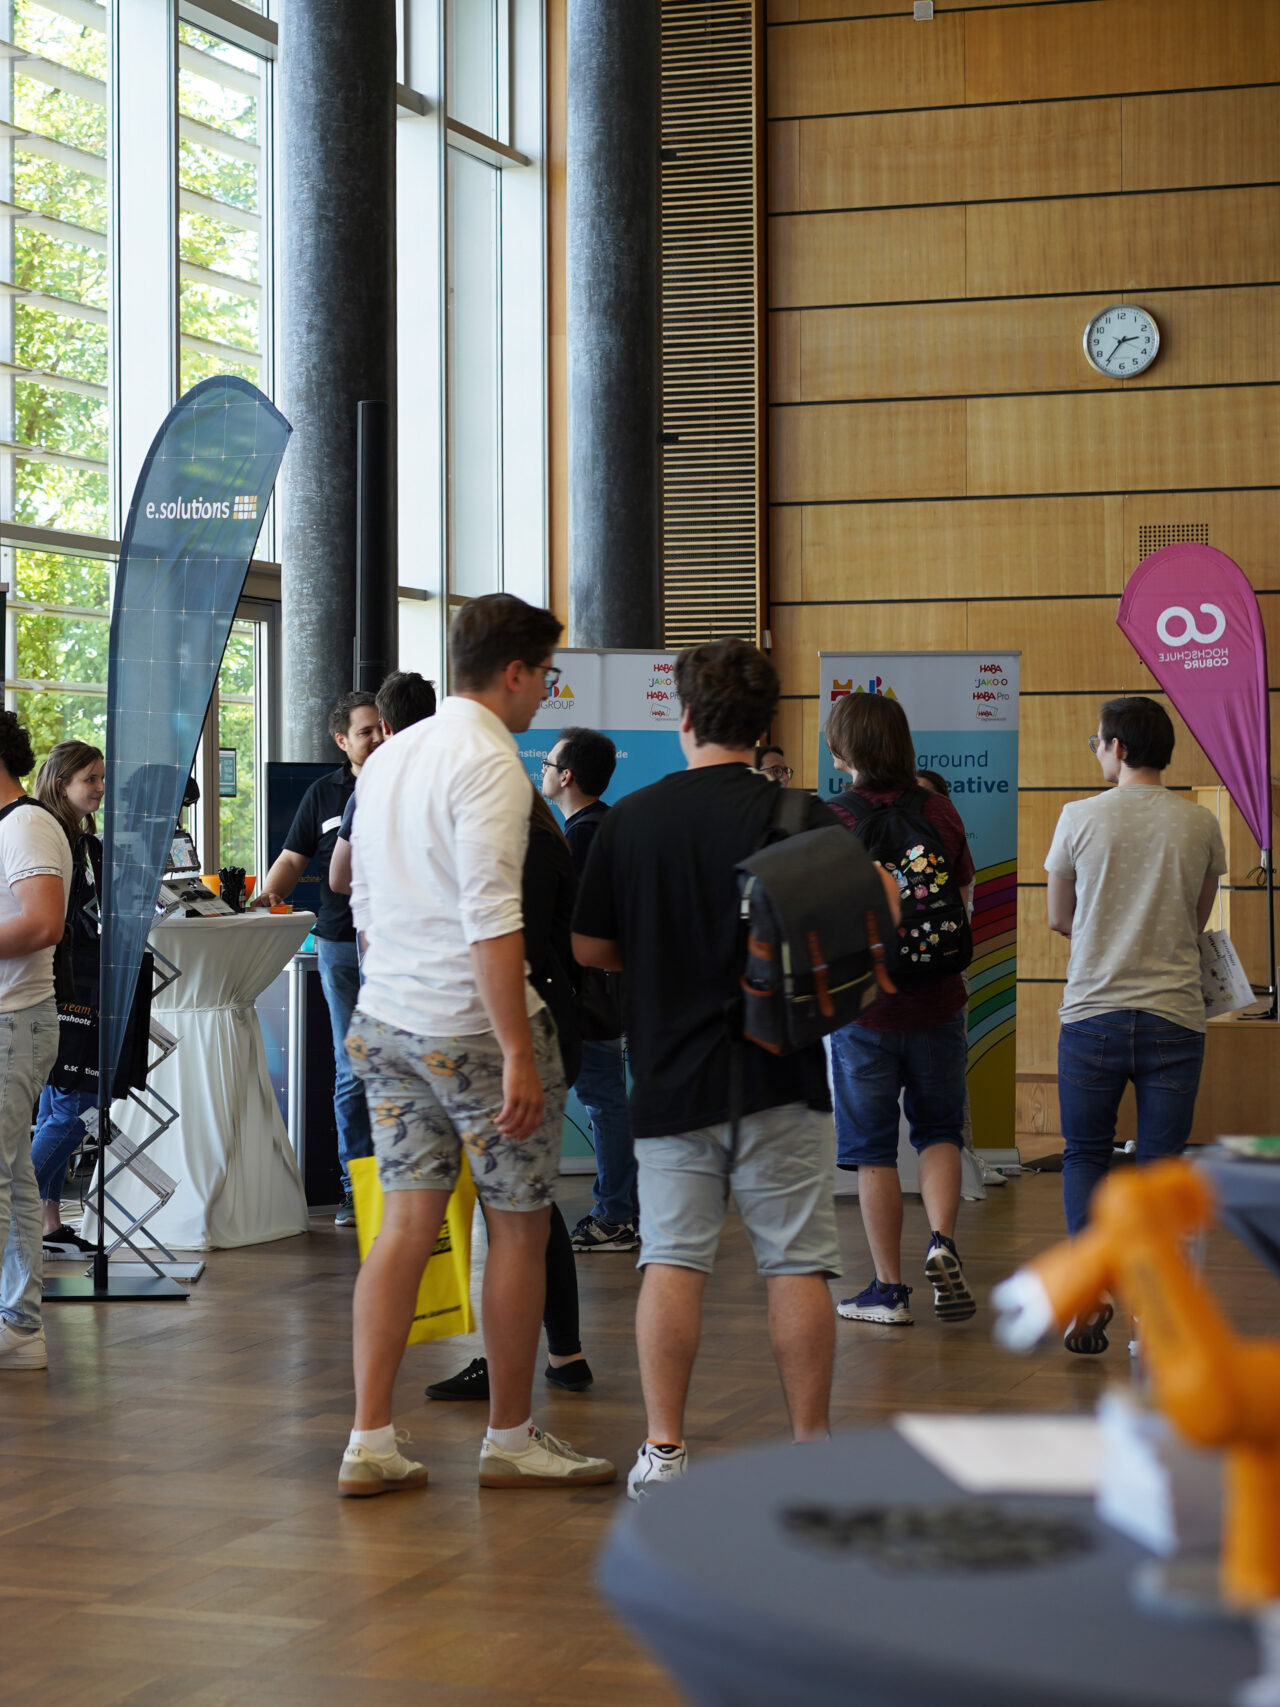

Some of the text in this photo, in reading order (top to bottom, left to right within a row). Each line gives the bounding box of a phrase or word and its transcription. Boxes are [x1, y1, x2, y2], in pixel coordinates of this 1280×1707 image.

[146, 496, 230, 519] e.solutions
[980, 664, 1002, 674] HABA
[646, 691, 669, 701] HABA
[972, 692, 1009, 702] HABA Pro
[540, 700, 574, 710] GROUP
[519, 749, 548, 759] nstieg
[917, 751, 988, 770] ground
[947, 777, 1009, 794] eative
[57, 1014, 92, 1026] goshoote
